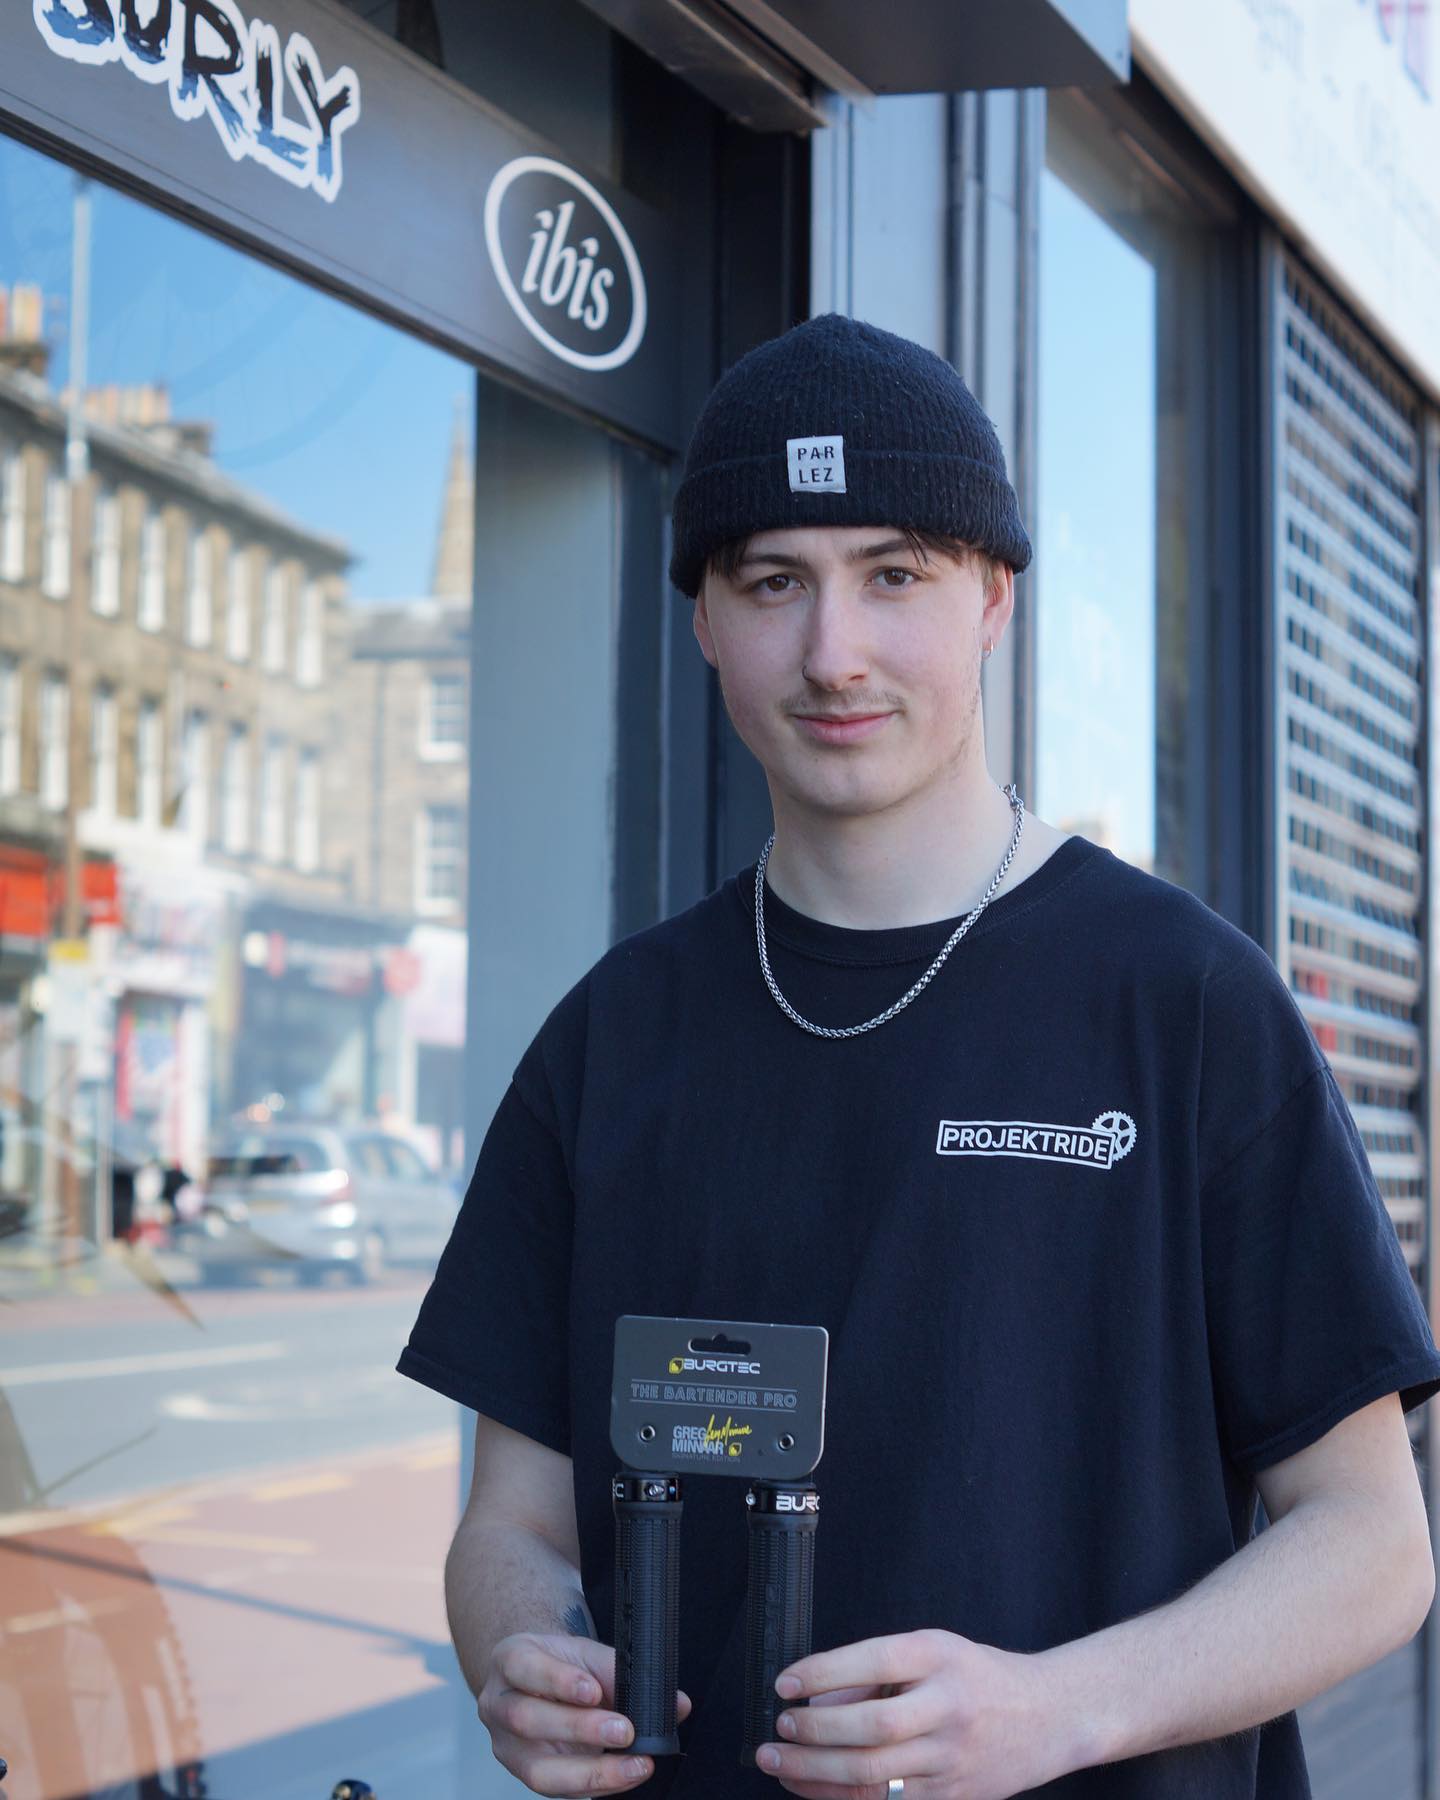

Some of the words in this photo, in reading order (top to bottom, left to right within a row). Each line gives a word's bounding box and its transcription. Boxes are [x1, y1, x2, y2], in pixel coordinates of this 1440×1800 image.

[521, 200, 614, 330] ibis
[797, 445, 834, 461] PAR
[798, 467, 834, 484] LEZ
[942, 1128, 1110, 1161] PROJEKTRIDE
[683, 1358, 761, 1374] BURGTEC
[630, 1383, 659, 1399] THE
[664, 1385, 758, 1406] BARTENDER
[763, 1393, 797, 1408] PRO
[673, 1425, 706, 1440] GREG
